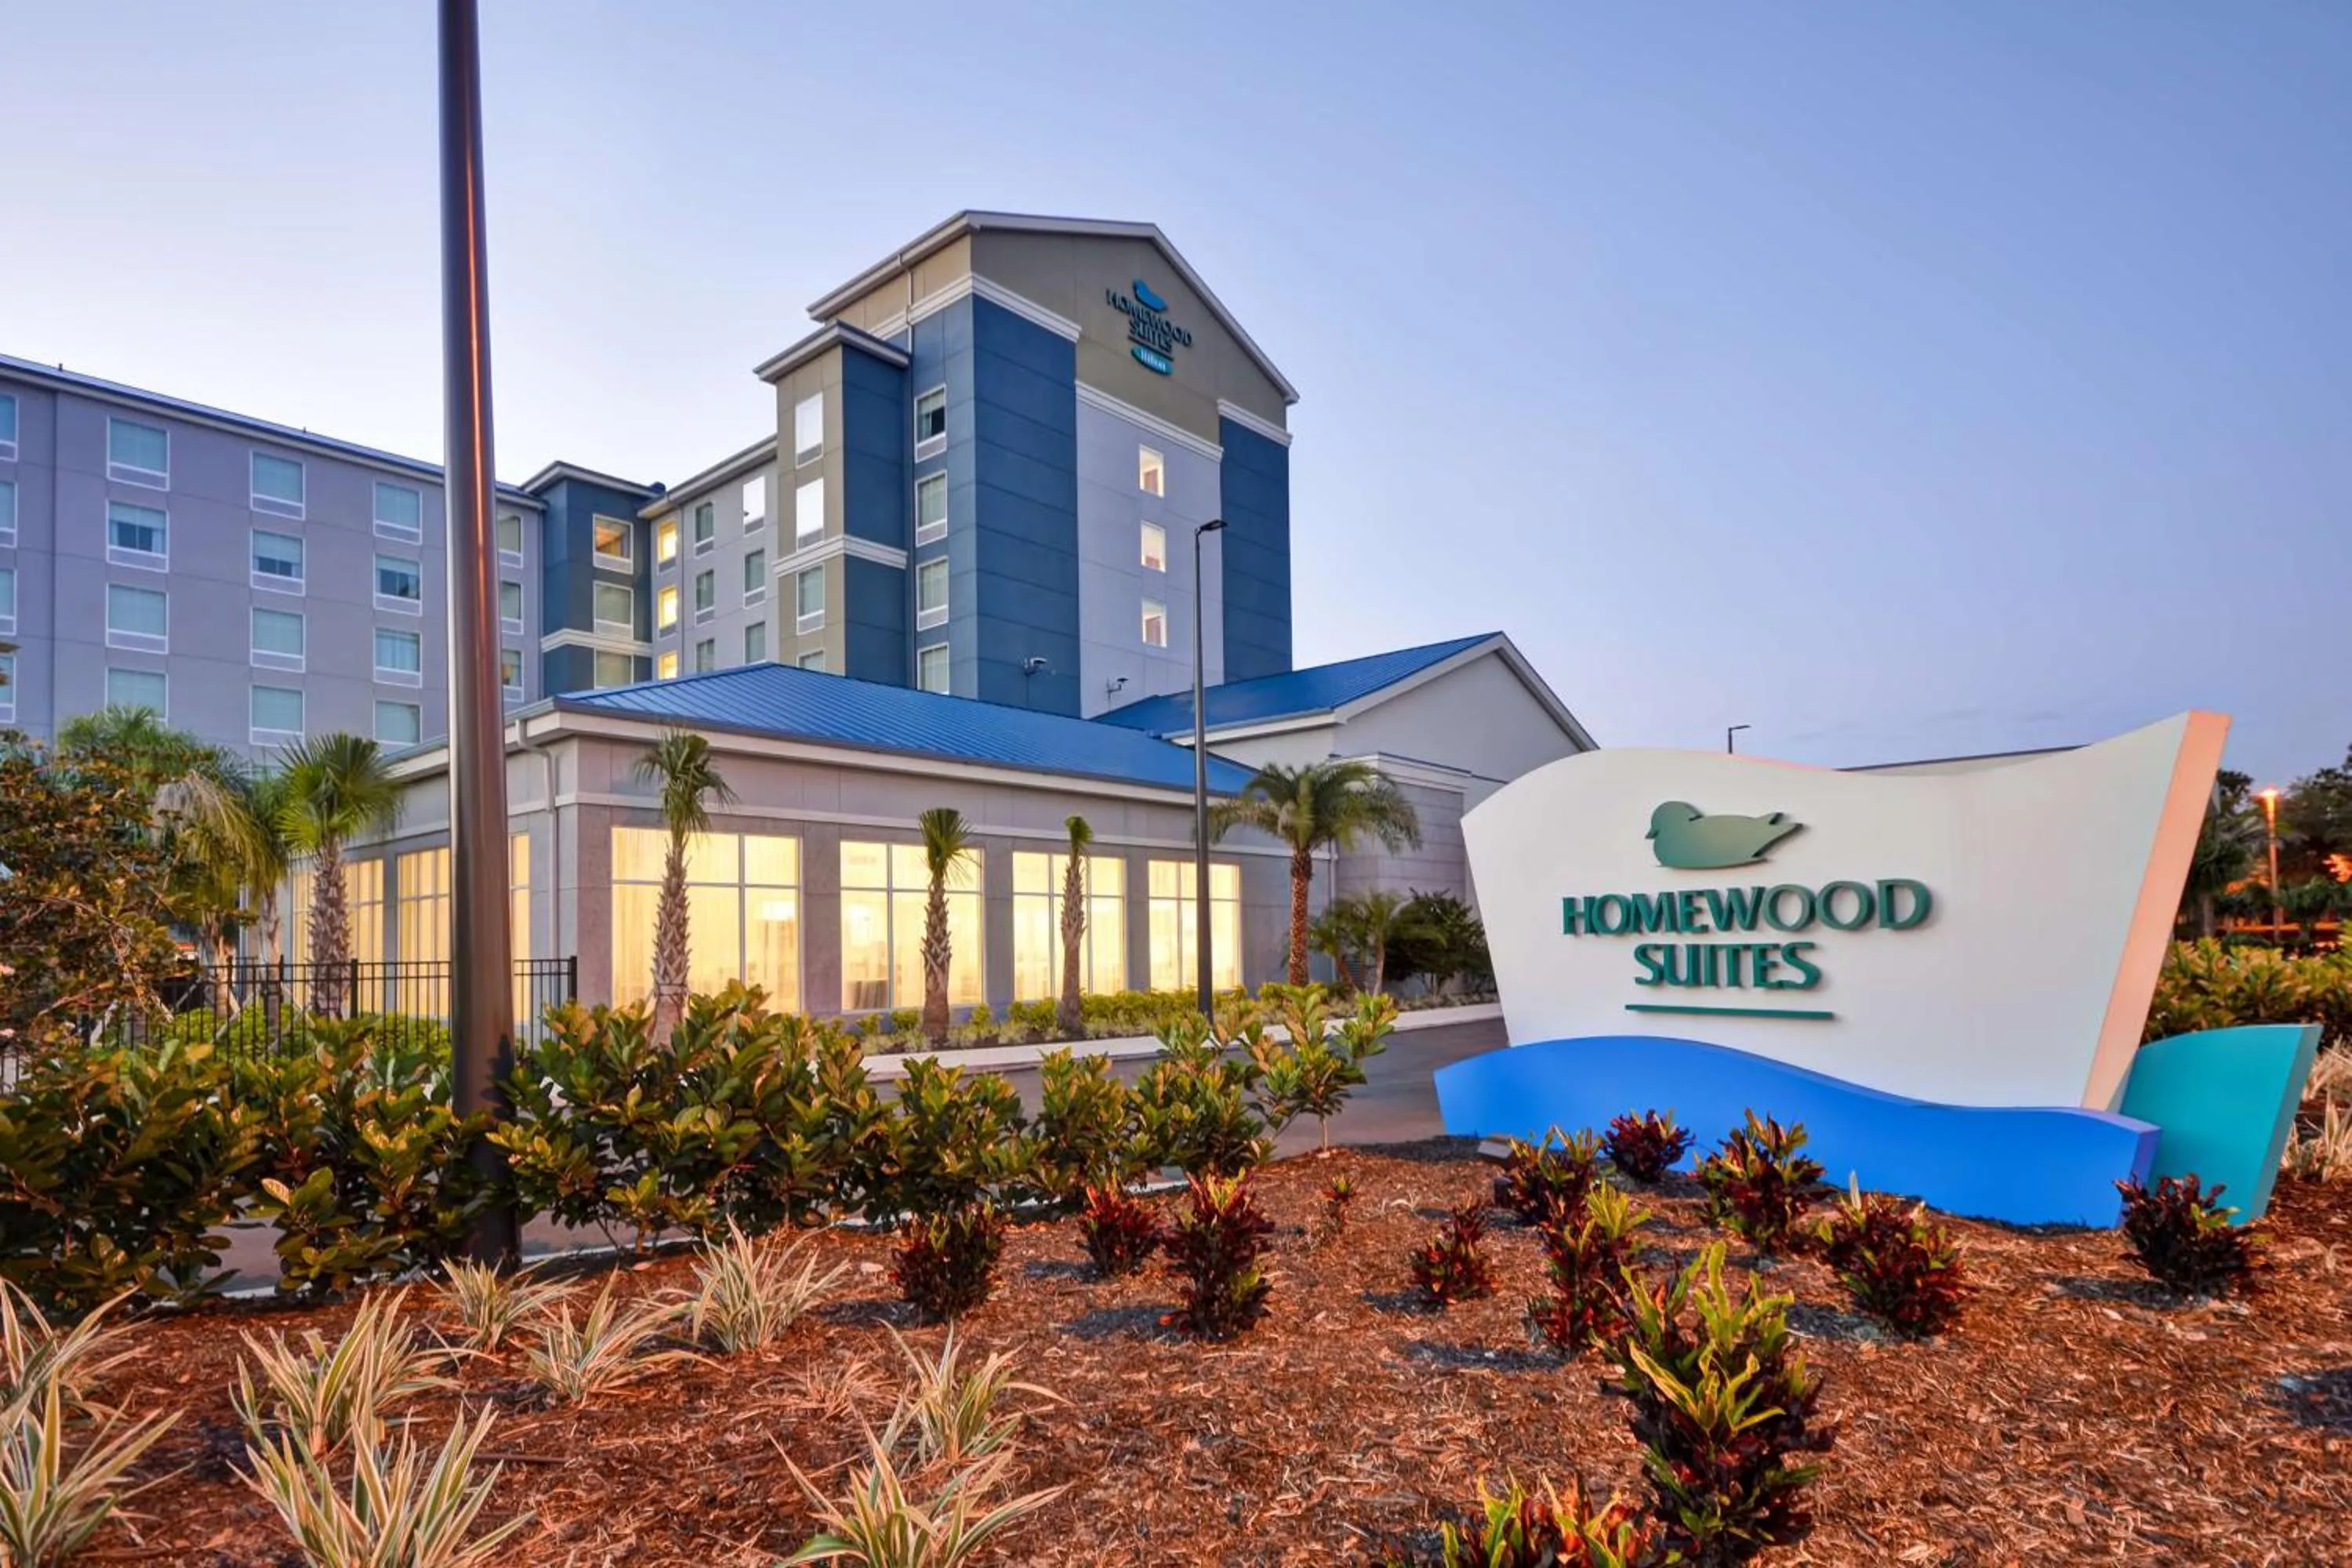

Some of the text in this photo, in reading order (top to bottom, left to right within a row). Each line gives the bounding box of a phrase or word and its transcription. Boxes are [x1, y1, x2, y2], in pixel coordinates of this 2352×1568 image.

[1105, 288, 1192, 347] HOMEWOOD
[1129, 319, 1172, 354] SUITES
[1562, 879, 1933, 935] HOMEWOOD
[1633, 942, 1823, 990] SUITES
